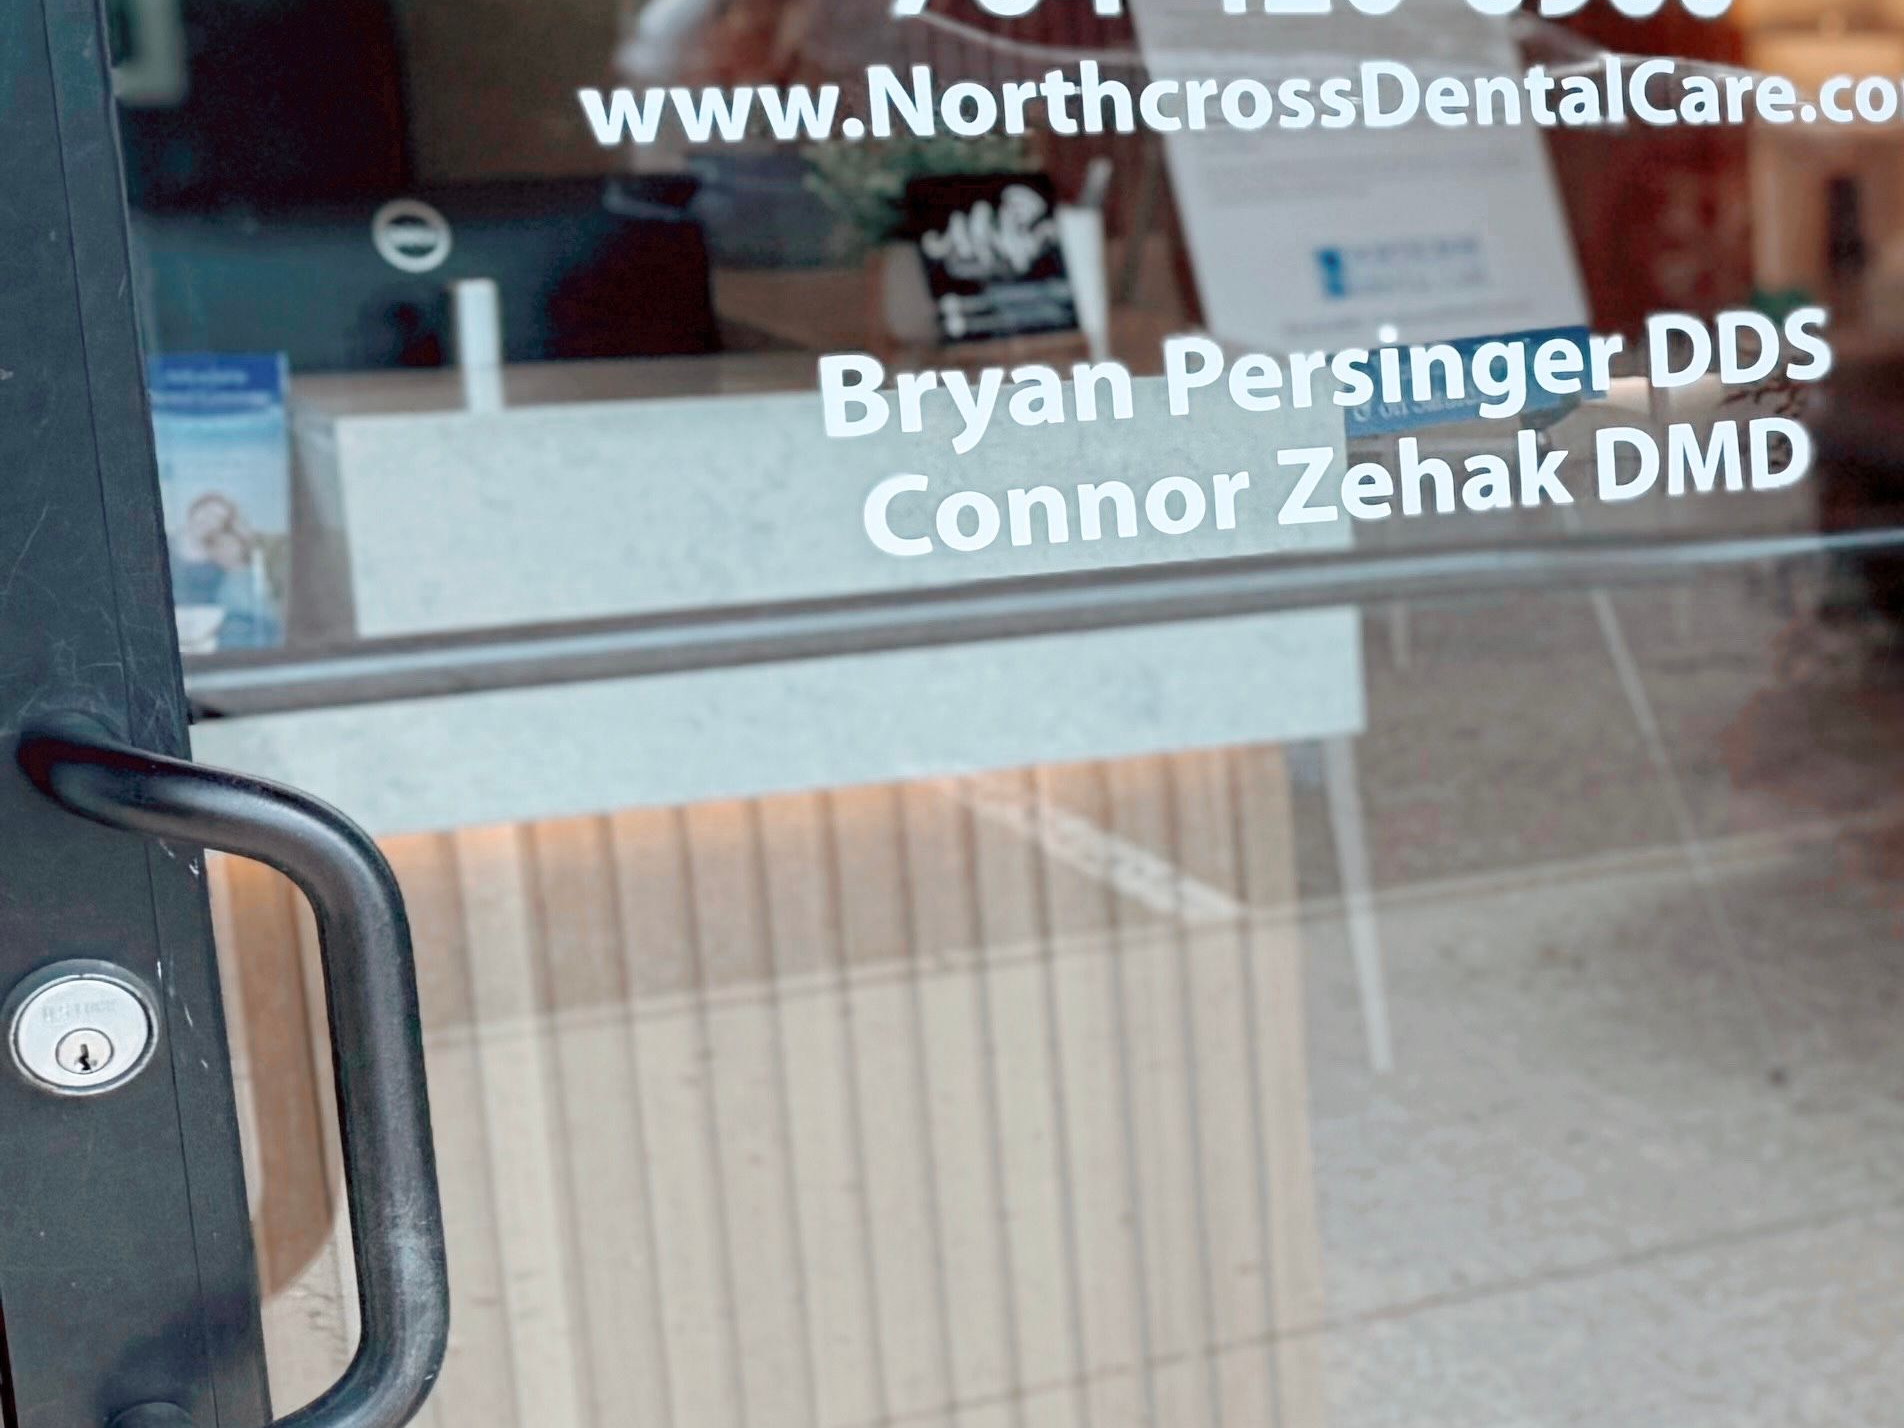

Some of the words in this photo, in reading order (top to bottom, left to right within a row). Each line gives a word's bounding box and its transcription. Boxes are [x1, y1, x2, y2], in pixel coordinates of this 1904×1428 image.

[818, 353, 1136, 457] Bryan
[1164, 324, 1624, 421] Persinger
[1647, 307, 1832, 389] DDS
[862, 470, 1251, 558] Connor
[1276, 428, 1576, 527] Zehak
[1594, 416, 1811, 502] DMD
